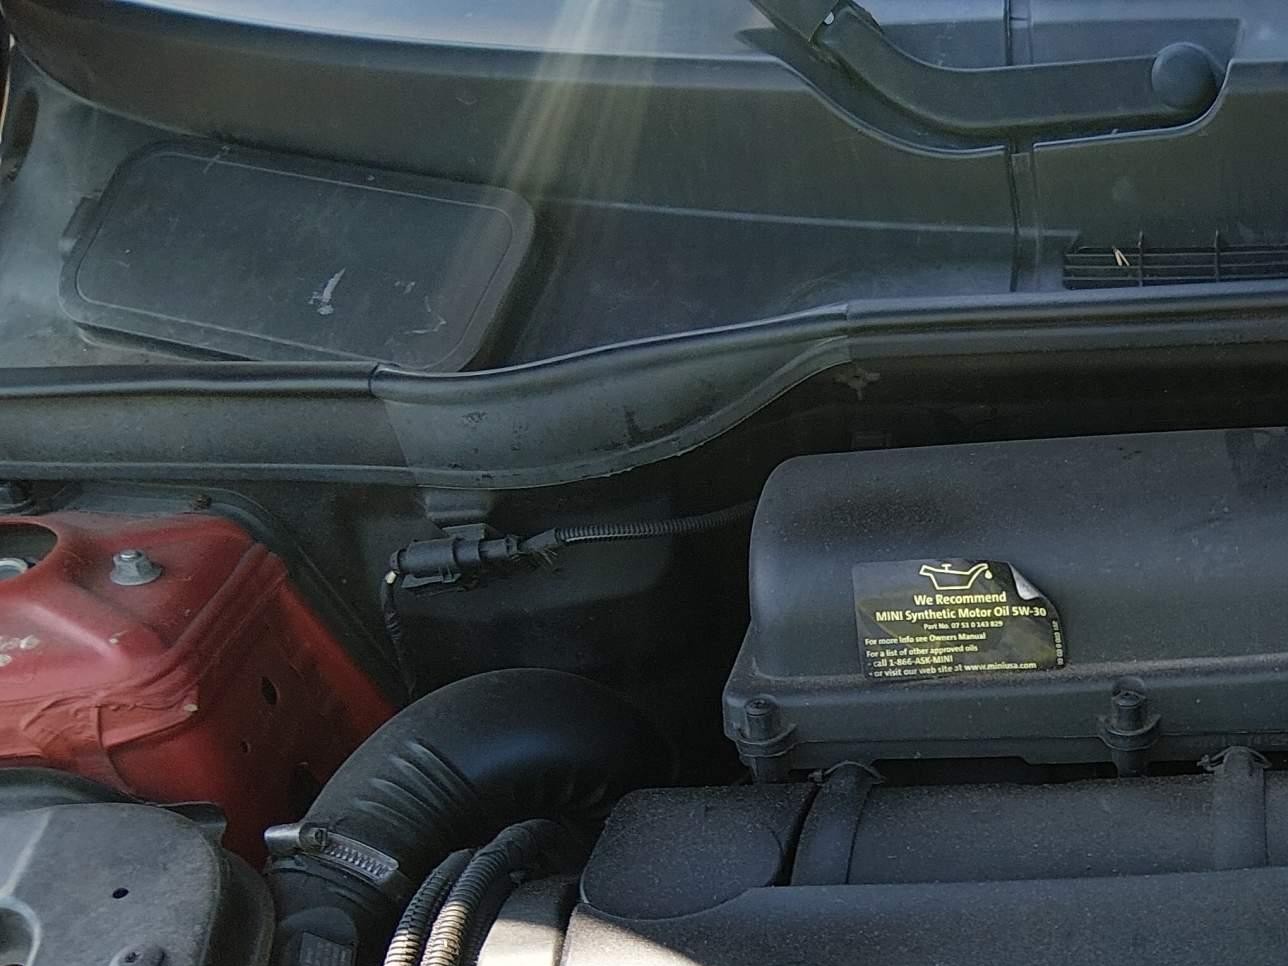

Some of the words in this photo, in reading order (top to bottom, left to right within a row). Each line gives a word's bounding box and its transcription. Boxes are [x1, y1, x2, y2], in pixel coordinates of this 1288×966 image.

[913, 594, 934, 605] We
[935, 591, 1007, 605] Recommend
[875, 611, 904, 622] MINI
[905, 608, 956, 623] Synthetic
[958, 607, 992, 618] Motor
[993, 606, 1010, 616] Oil
[1012, 606, 1047, 617] 5W-30
[929, 634, 957, 642] Owners
[958, 632, 987, 640] Manual
[866, 650, 879, 658] For
[886, 649, 898, 657] list
[899, 648, 908, 656] of
[908, 647, 929, 655] other
[929, 645, 964, 655] approved
[965, 644, 978, 652] oils
[873, 658, 887, 667] call
[888, 654, 953, 667] 1-866-ASK-MINI
[883, 668, 902, 677] visit
[918, 666, 937, 674] web
[937, 664, 953, 673] site
[954, 664, 962, 672] at
[963, 661, 1037, 672] www.miniusa.com
